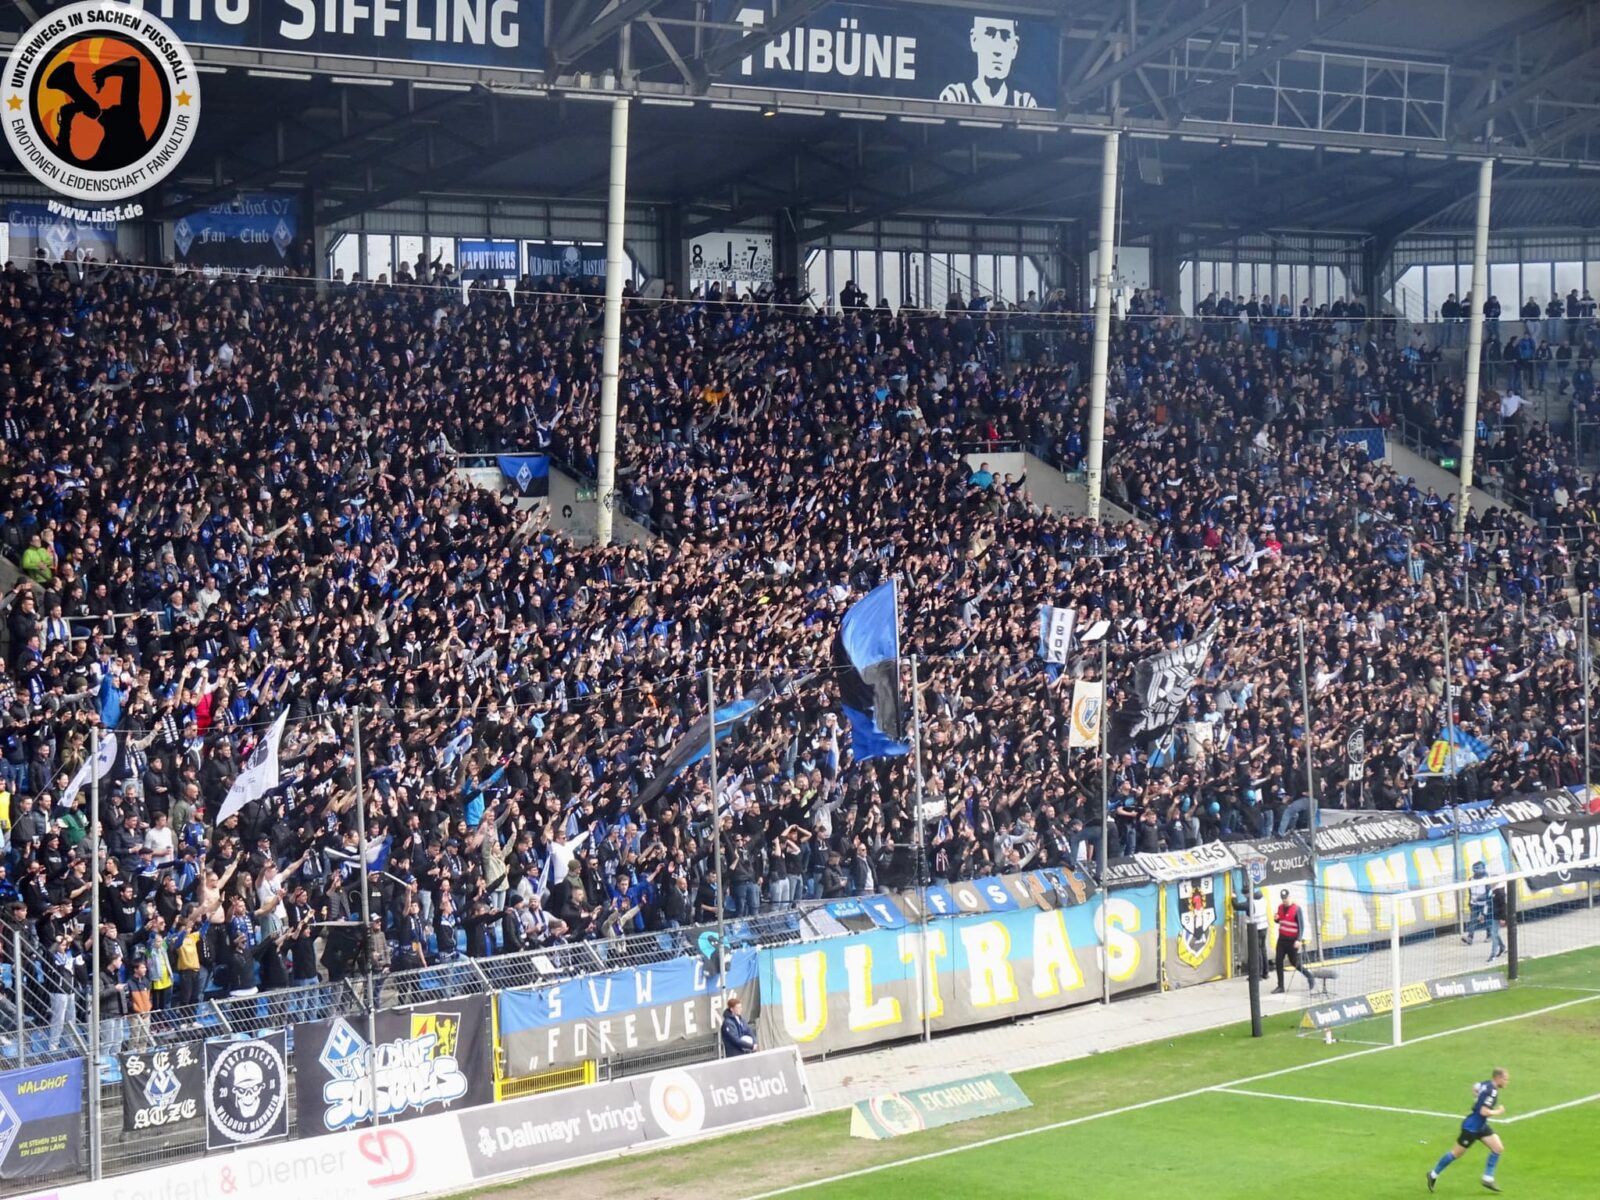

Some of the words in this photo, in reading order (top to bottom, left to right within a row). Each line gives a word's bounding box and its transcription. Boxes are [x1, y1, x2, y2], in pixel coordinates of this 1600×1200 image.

[280, 0, 519, 48] SIFFLING
[736, 8, 916, 81] TRIBÜNE
[198, 227, 226, 244] Fan
[240, 228, 270, 244] Club
[692, 244, 703, 269] 8
[719, 241, 732, 272] J
[747, 246, 758, 269] 7
[873, 880, 1028, 924] TIFOSI
[774, 896, 1142, 1043] ULTRAS
[1436, 981, 1466, 996] bwin
[1472, 976, 1501, 992] bwin
[1315, 1009, 1341, 1025] bwin
[1343, 1002, 1369, 1018] bwin
[220, 1049, 245, 1077] DIRTY
[249, 1047, 275, 1070] DICKS
[17, 1075, 69, 1095] WALDHOF
[918, 1079, 1001, 1111] EICHBAUM
[497, 1118, 581, 1152] Dallmayr
[587, 1102, 646, 1134] bringt
[710, 1080, 740, 1108] ins
[742, 1070, 790, 1099] Büro!
[220, 1166, 238, 1194] &
[247, 1149, 346, 1188] Diemer
